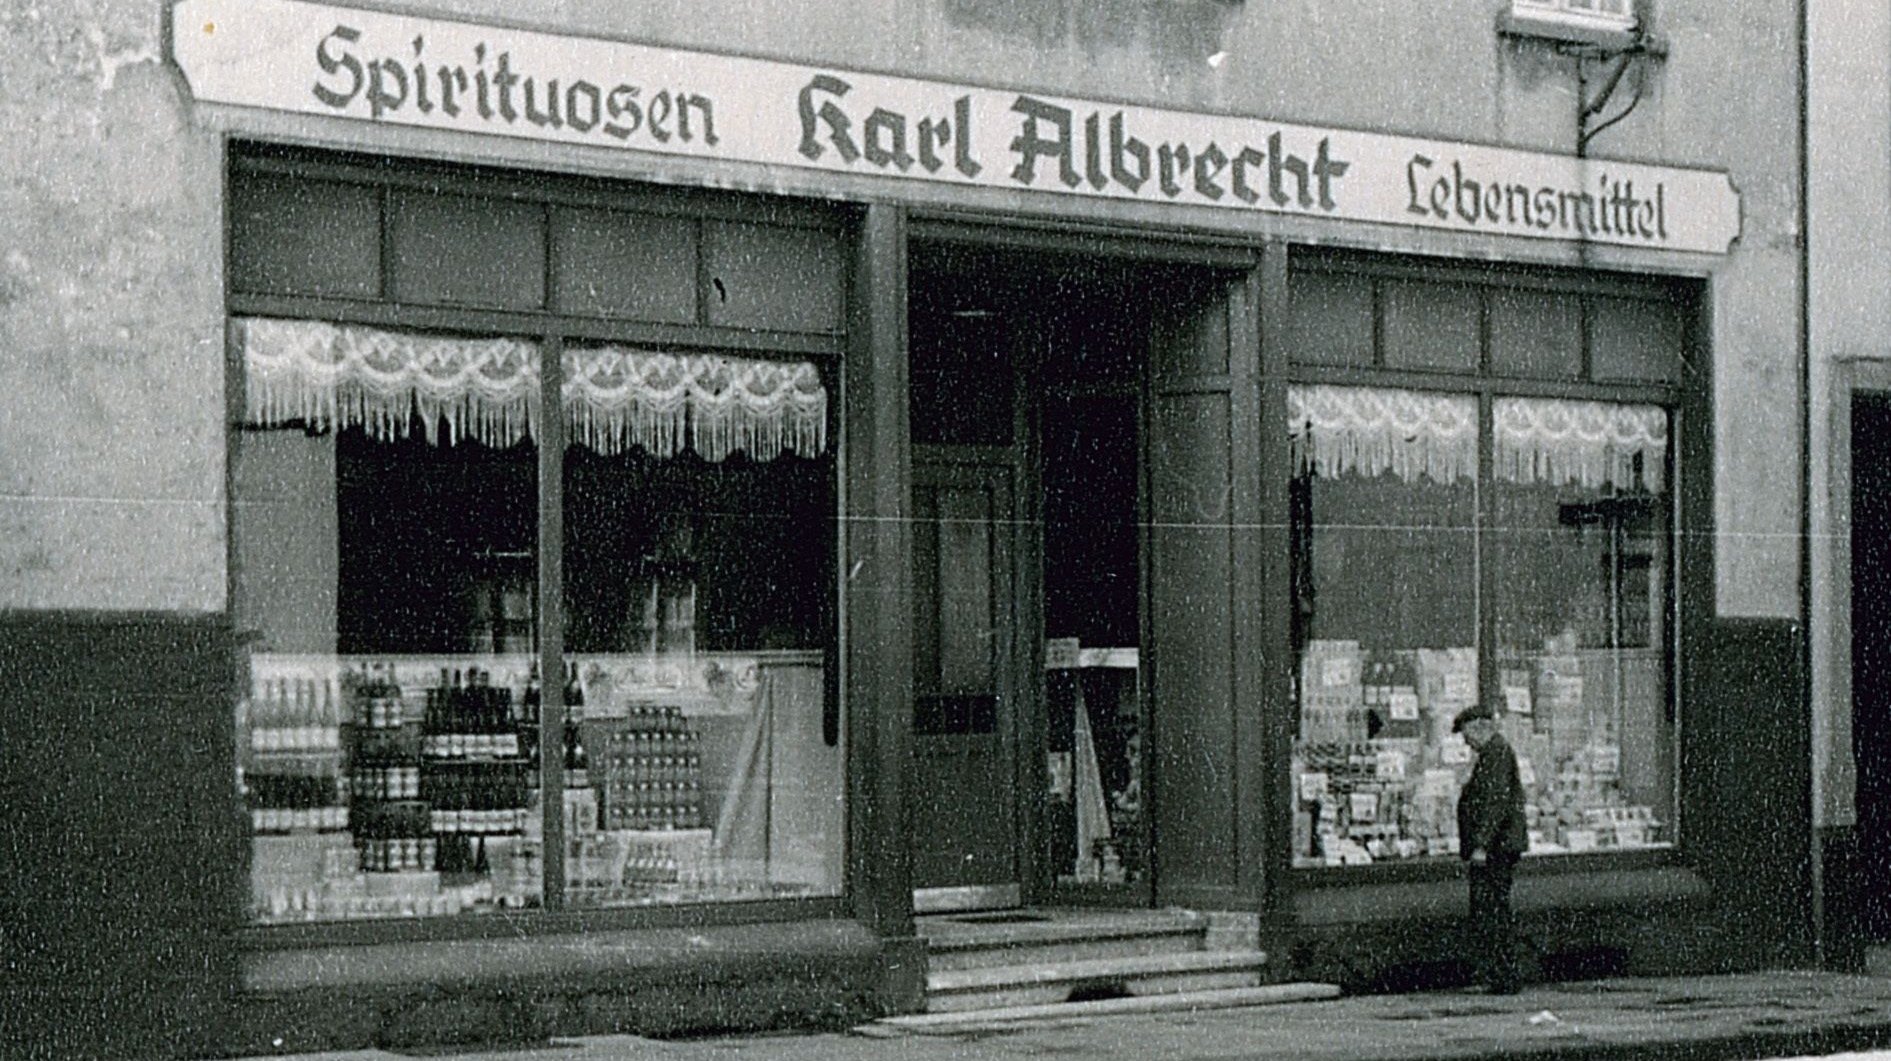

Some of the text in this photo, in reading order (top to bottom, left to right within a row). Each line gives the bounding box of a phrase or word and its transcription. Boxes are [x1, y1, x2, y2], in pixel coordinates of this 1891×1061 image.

[312, 25, 1667, 240] Spirituosen Karl Albrecht Lebensmittel
